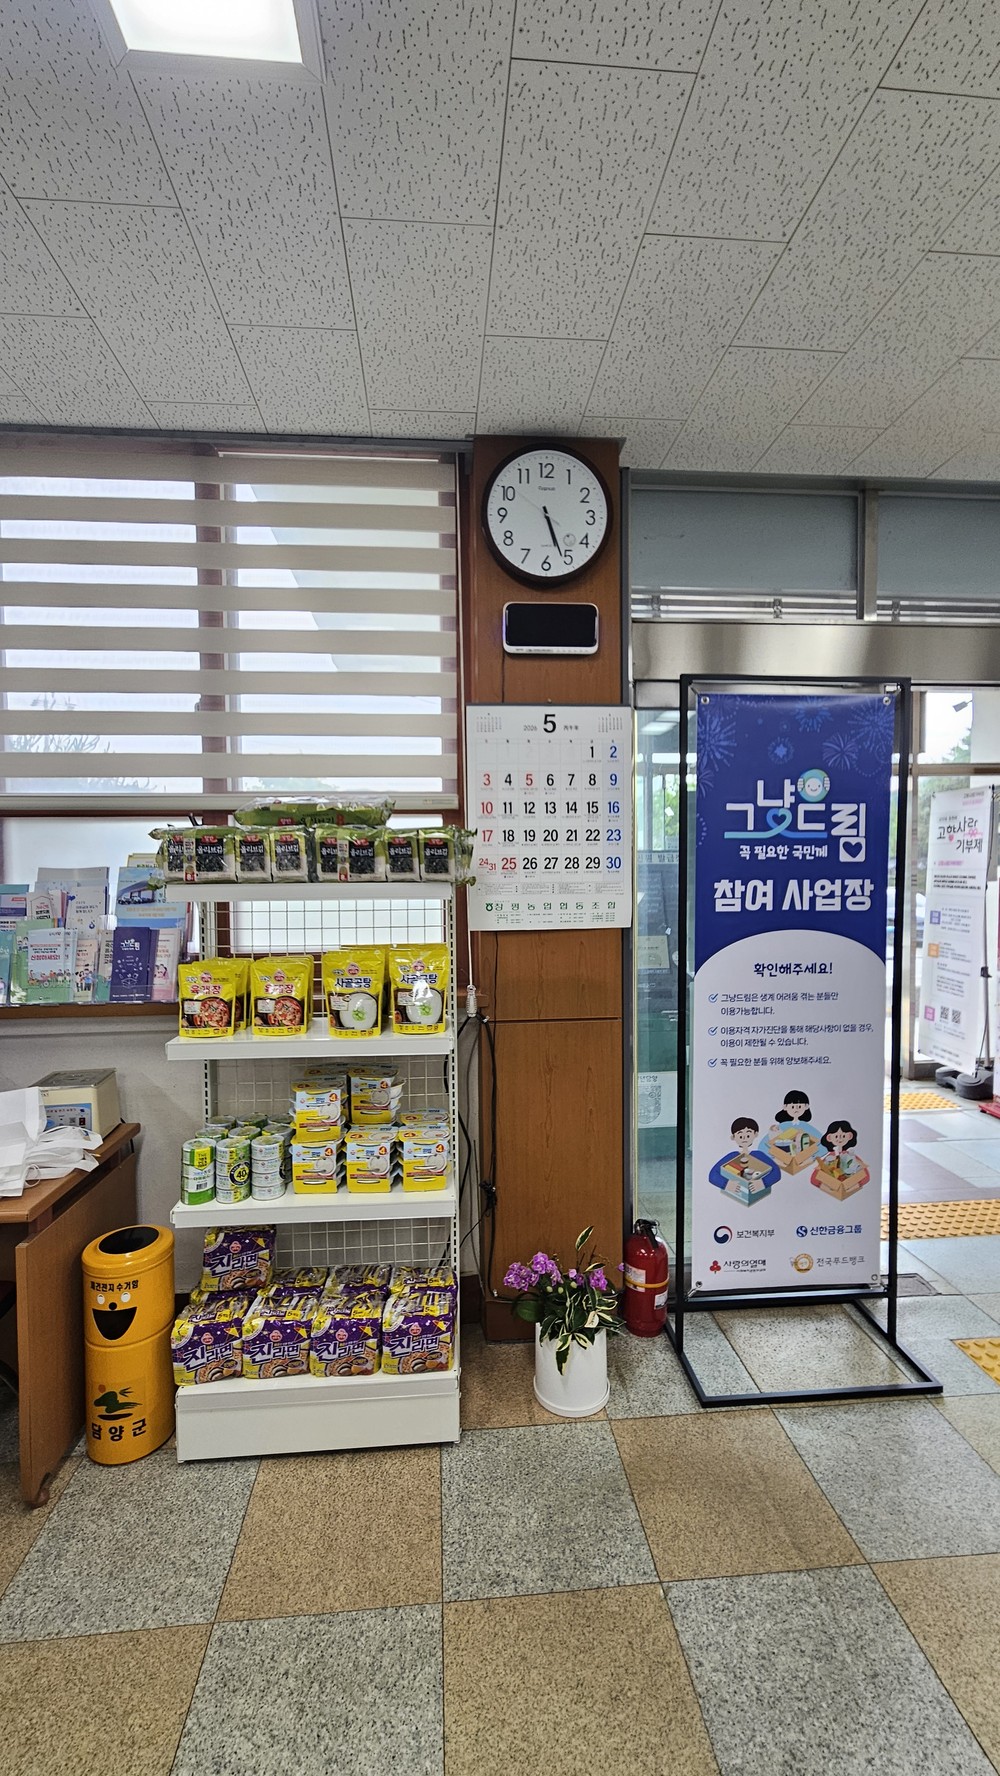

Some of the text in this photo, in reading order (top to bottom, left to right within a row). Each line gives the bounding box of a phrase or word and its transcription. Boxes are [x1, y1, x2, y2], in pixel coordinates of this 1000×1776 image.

[518, 468, 529, 484] 11
[539, 463, 554, 478] 12
[566, 469, 571, 484] 1
[501, 486, 515, 501] 10
[580, 488, 590, 503] 2
[498, 507, 507, 523] 9
[586, 510, 595, 525] 3
[504, 530, 514, 546] 8
[579, 533, 589, 548] 4
[521, 549, 530, 564] 7
[541, 556, 551, 571] 6
[564, 550, 573, 565] 5
[543, 714, 557, 733] 5
[589, 746, 617, 758] 1 2
[483, 774, 617, 786] 3 4 5 6 7 8 9
[481, 801, 620, 814] 10 11 12 13 14 15 16
[482, 829, 621, 842] 17 18 19 20 21 22 23
[740, 845, 827, 860] 꼭 필요한 국민께
[479, 857, 621, 871] 24 31 25 26 27 28 29 30
[714, 879, 874, 912] 참여 사업장
[753, 962, 833, 977] 확인해주세요!
[721, 992, 838, 1002] 그냥드림은 생계 어려움 겪는 분들만
[721, 1007, 775, 1016] 이용가능합니다.
[720, 1026, 750, 1035] 이용자격
[751, 1025, 788, 1034] 자가진단을
[789, 1025, 804, 1034] 통해
[805, 1025, 841, 1033] 해당사항이
[858, 1024, 874, 1032] 경우,
[720, 1039, 743, 1047] 이용이
[777, 1038, 808, 1046] 있습니다.
[720, 1056, 831, 1067] 꼭 필요한 분들 위해 양보해주세요.
[236, 1169, 247, 1178] 40
[737, 1229, 775, 1238] 보건복지부
[810, 1224, 862, 1236] 신한금융그룹
[210, 1253, 258, 1277] 진라면
[817, 1256, 865, 1267] 전국푸드뱅크
[250, 1342, 301, 1365] 진라면
[316, 1340, 365, 1362] 진라면
[390, 1336, 440, 1358] 진라면
[184, 1343, 233, 1372] 진라면
